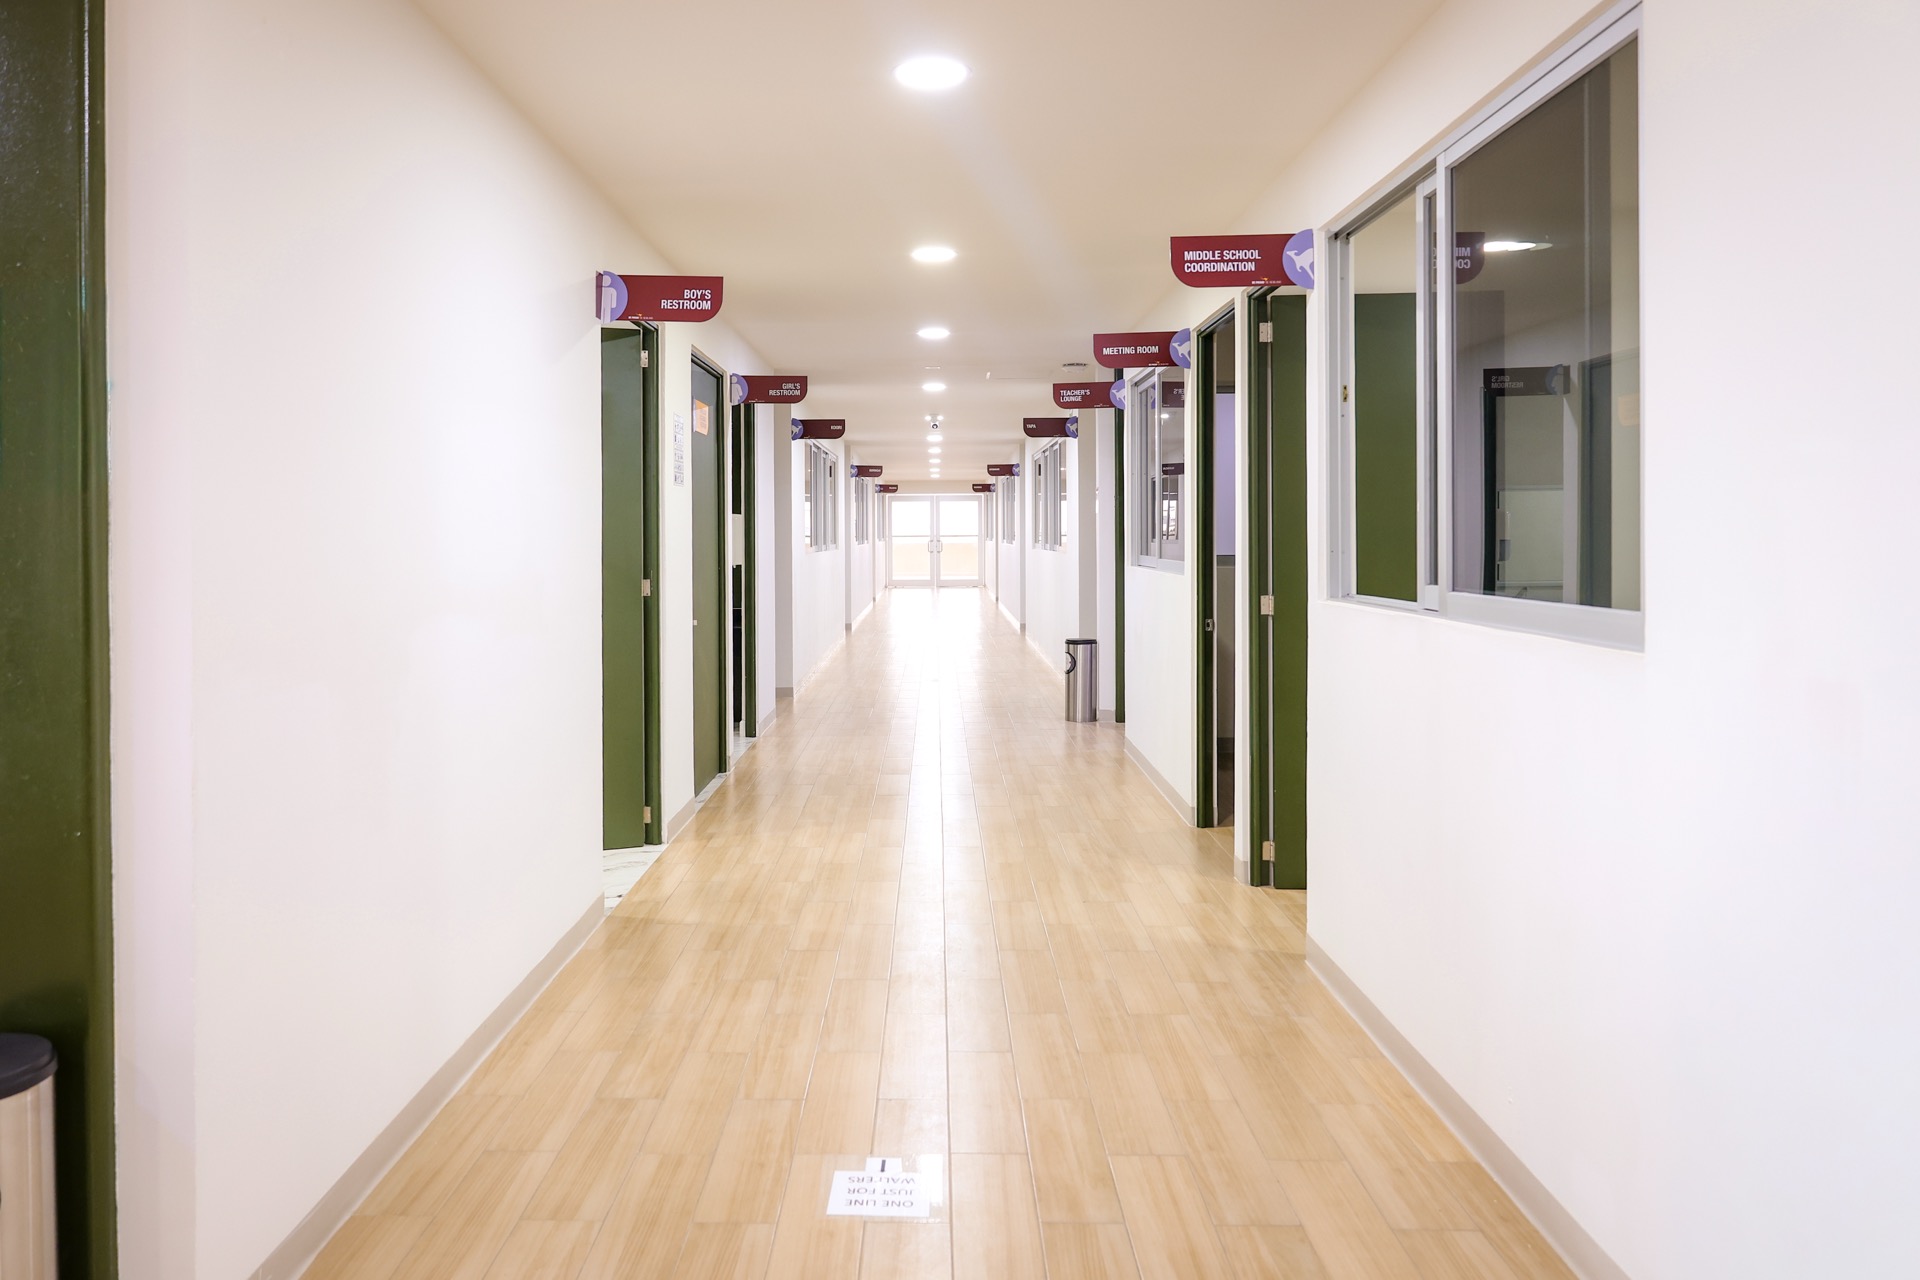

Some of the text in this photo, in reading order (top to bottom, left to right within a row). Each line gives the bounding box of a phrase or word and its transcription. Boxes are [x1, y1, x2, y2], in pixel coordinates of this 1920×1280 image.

[1184, 250, 1261, 261] MIDDLE SCHOOL
[1184, 262, 1255, 272] COORDINATION
[684, 289, 711, 299] BOY'S
[661, 300, 711, 310] RESTROOM
[1103, 346, 1158, 355] MEETING ROOM
[847, 1187, 876, 1195] FOR
[845, 1198, 914, 1208] ONE LINE
